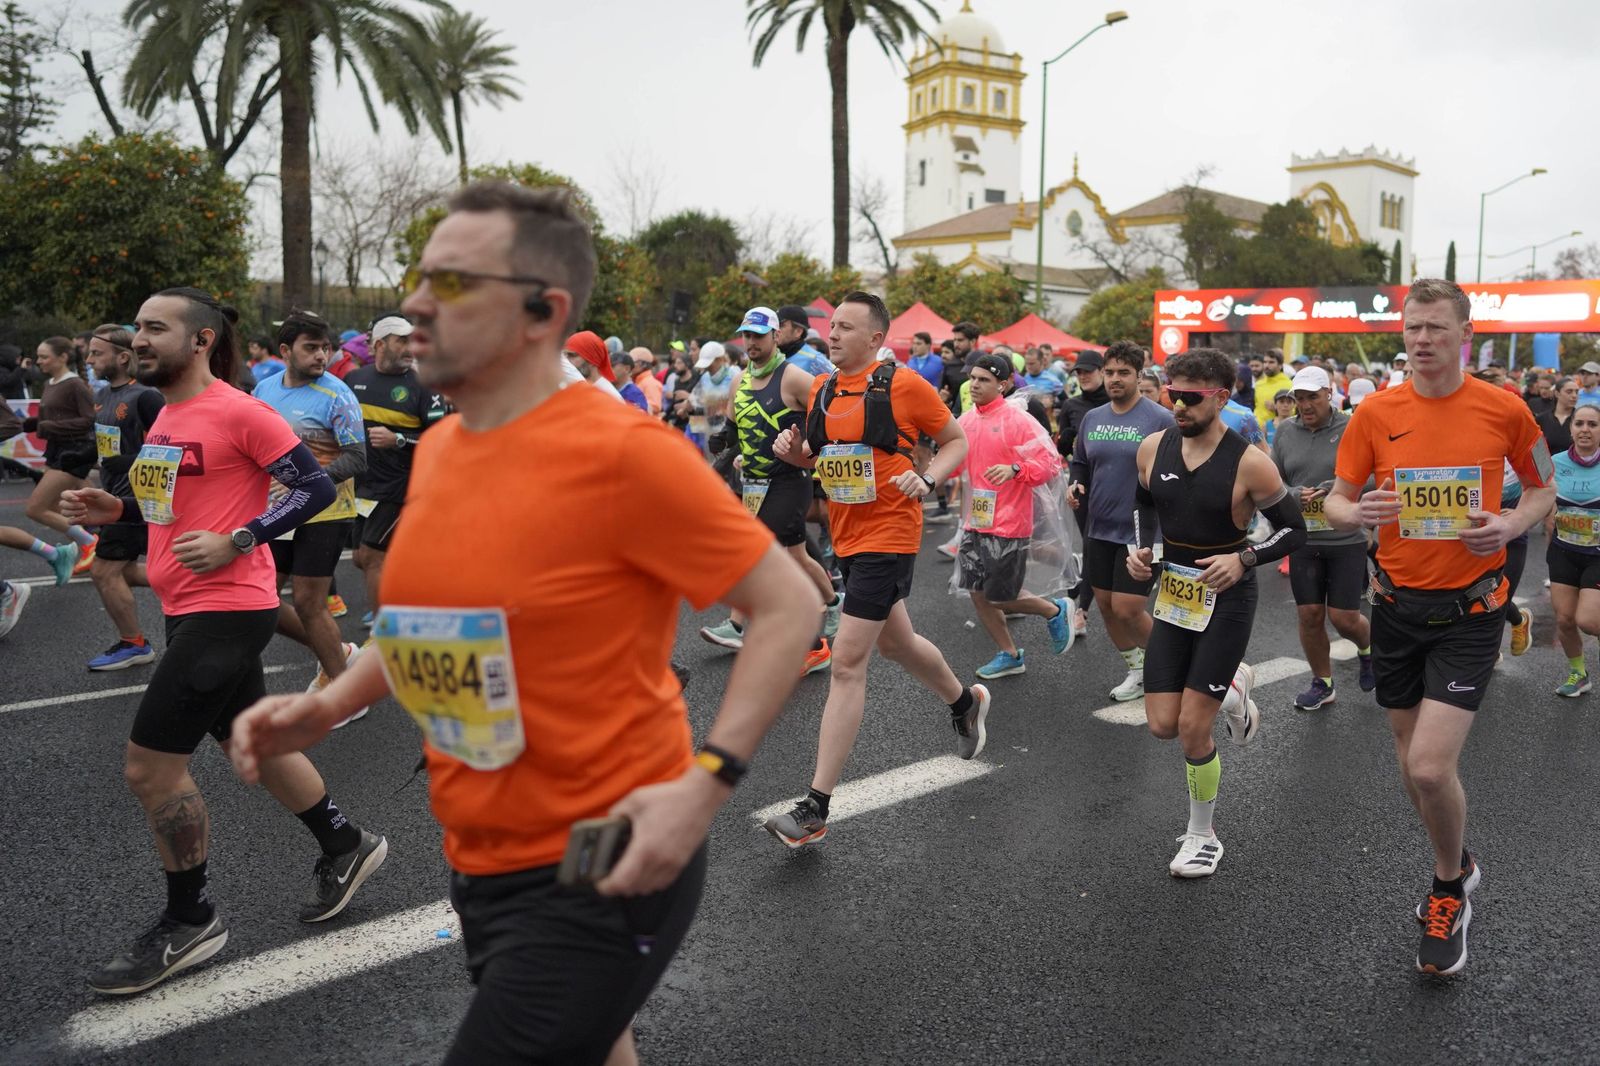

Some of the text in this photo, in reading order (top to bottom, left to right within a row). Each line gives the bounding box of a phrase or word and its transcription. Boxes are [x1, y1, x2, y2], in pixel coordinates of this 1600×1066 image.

[133, 463, 169, 490] 15275
[819, 459, 863, 478] 15019
[1403, 485, 1468, 508] 15016
[1165, 576, 1204, 603] 15231
[391, 646, 482, 699] 14984
